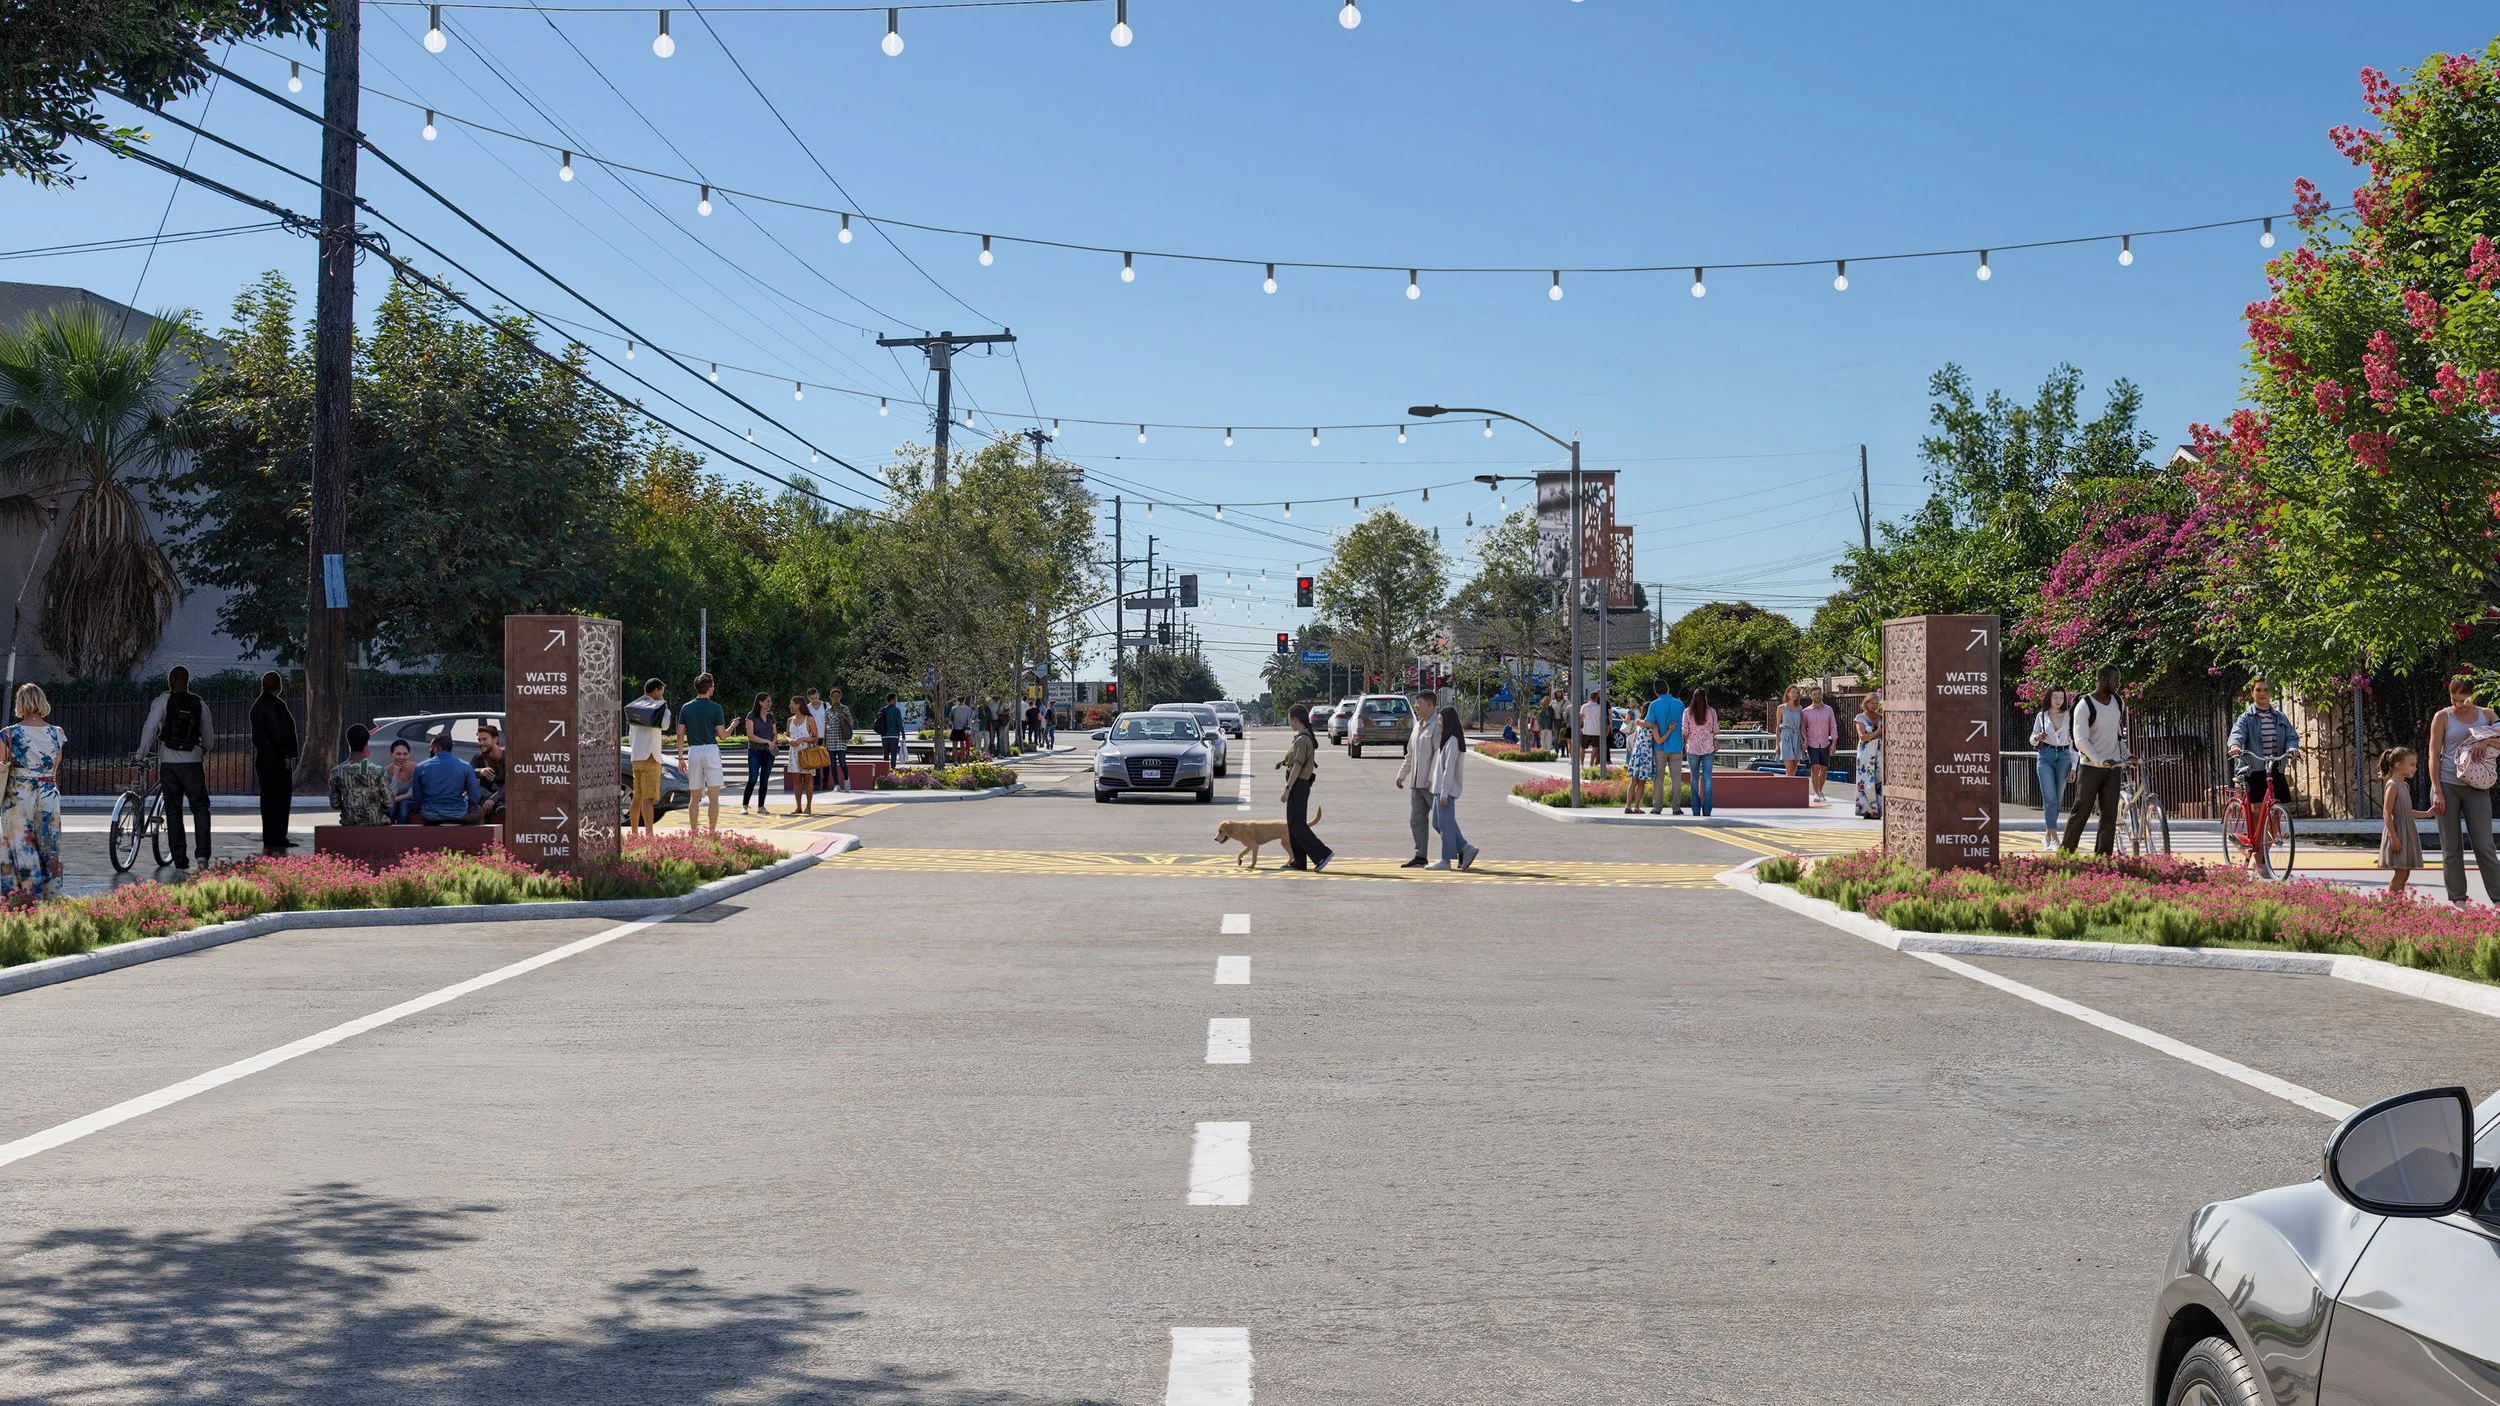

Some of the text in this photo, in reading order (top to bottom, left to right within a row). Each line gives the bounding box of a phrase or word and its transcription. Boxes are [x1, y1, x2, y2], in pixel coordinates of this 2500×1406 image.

[526, 672, 568, 682] WATTS
[1946, 672, 1988, 682] WATTS
[516, 685, 568, 695] TOWERS
[1936, 685, 1988, 695] TOWERS
[533, 753, 570, 762] WATTS
[1953, 753, 1991, 762] WATTS
[514, 764, 570, 774] CULTURAL
[1934, 765, 1991, 774] CULTURAL
[540, 776, 570, 785] TRAIL
[1960, 776, 1991, 785] TRAIL
[515, 833, 570, 844] METRO A
[1936, 834, 1990, 844] METRO A
[543, 846, 569, 857] LINE
[1963, 847, 1990, 857] LINE
